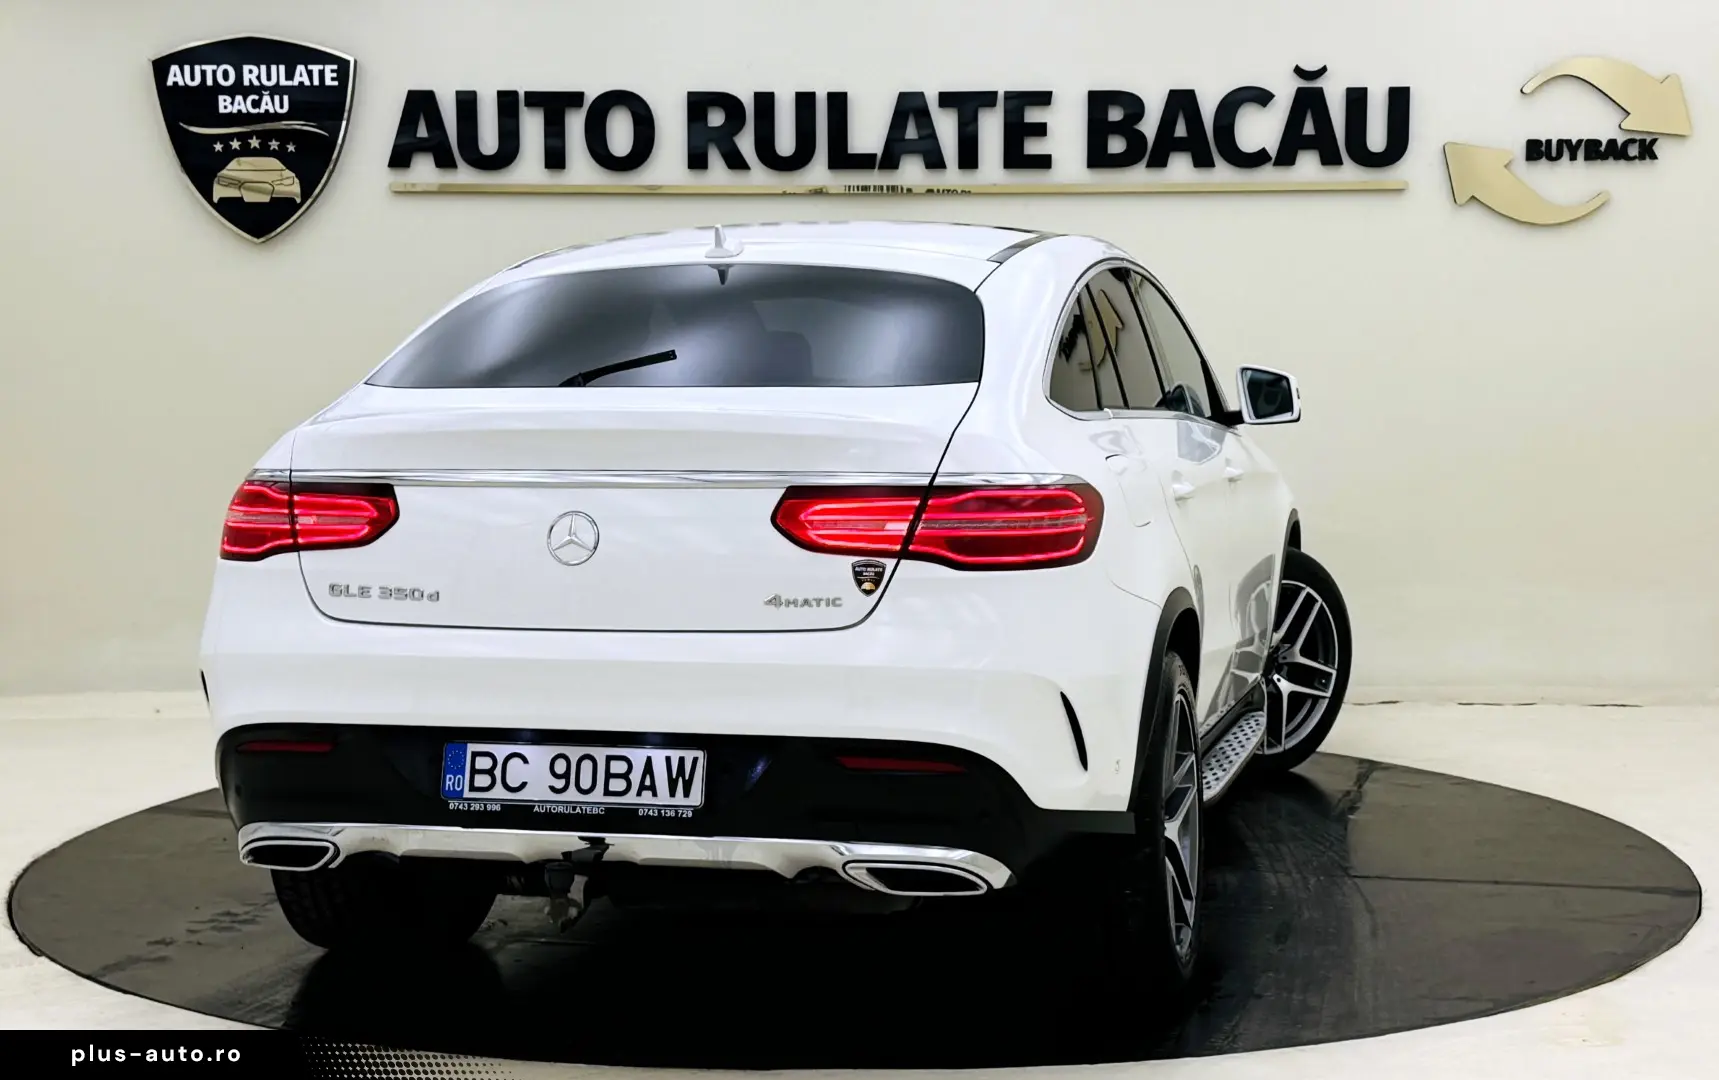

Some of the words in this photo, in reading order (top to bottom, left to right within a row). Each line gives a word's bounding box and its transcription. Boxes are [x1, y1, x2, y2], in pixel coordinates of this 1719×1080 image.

[166, 64, 236, 87] AUTO
[242, 64, 339, 87] RULATE
[217, 91, 290, 114] BACĂU
[387, 89, 656, 172] AUTO
[687, 90, 1054, 171] RULATE
[1086, 64, 1411, 169] BACĂU
[1525, 138, 1659, 162] BUYBACK
[328, 582, 372, 599] GLE
[763, 593, 843, 610] 4MATIC
[445, 773, 464, 792] RO
[468, 750, 530, 794] BC
[548, 752, 699, 799] 90BAW
[449, 802, 468, 811] 0743
[533, 805, 605, 815] AUTORULATEBC
[638, 808, 659, 817] 0743
[660, 809, 676, 818] 136
[677, 810, 693, 818] 729
